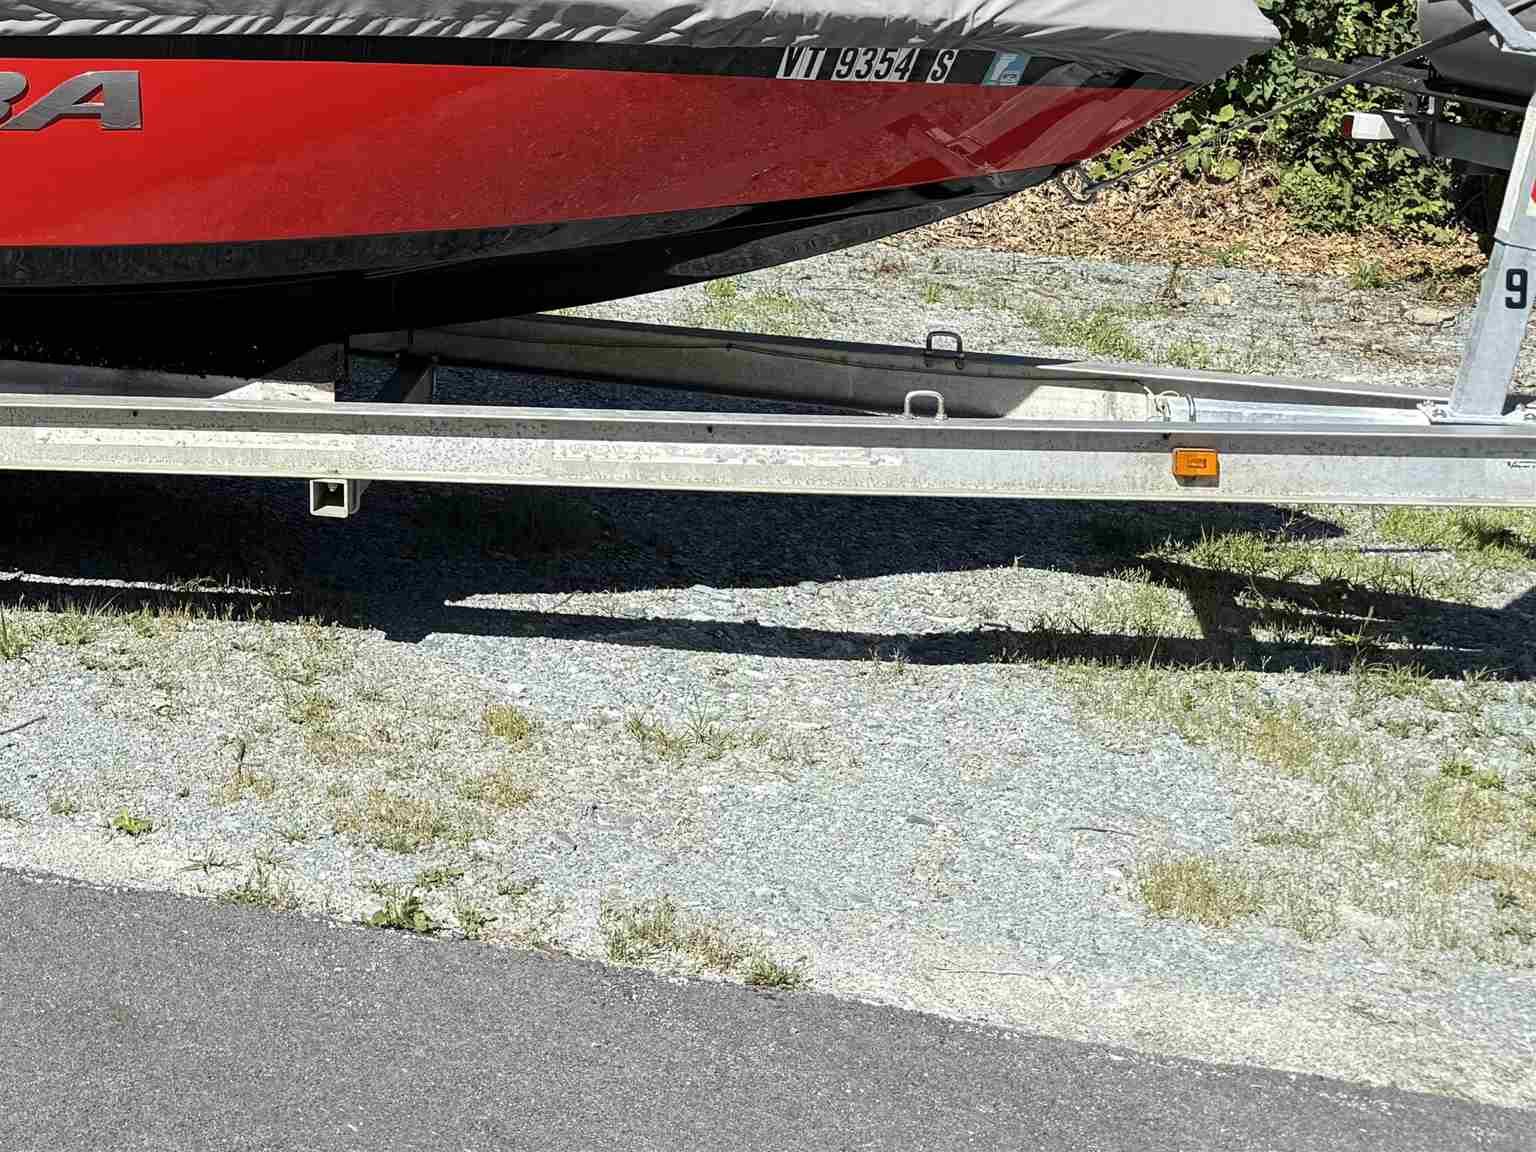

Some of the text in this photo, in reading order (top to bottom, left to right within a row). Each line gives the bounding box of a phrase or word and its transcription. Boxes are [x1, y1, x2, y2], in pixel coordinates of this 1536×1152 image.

[783, 46, 826, 79] VT
[835, 47, 914, 81] 9354
[930, 49, 955, 82] S
[1505, 268, 1528, 309] 9
